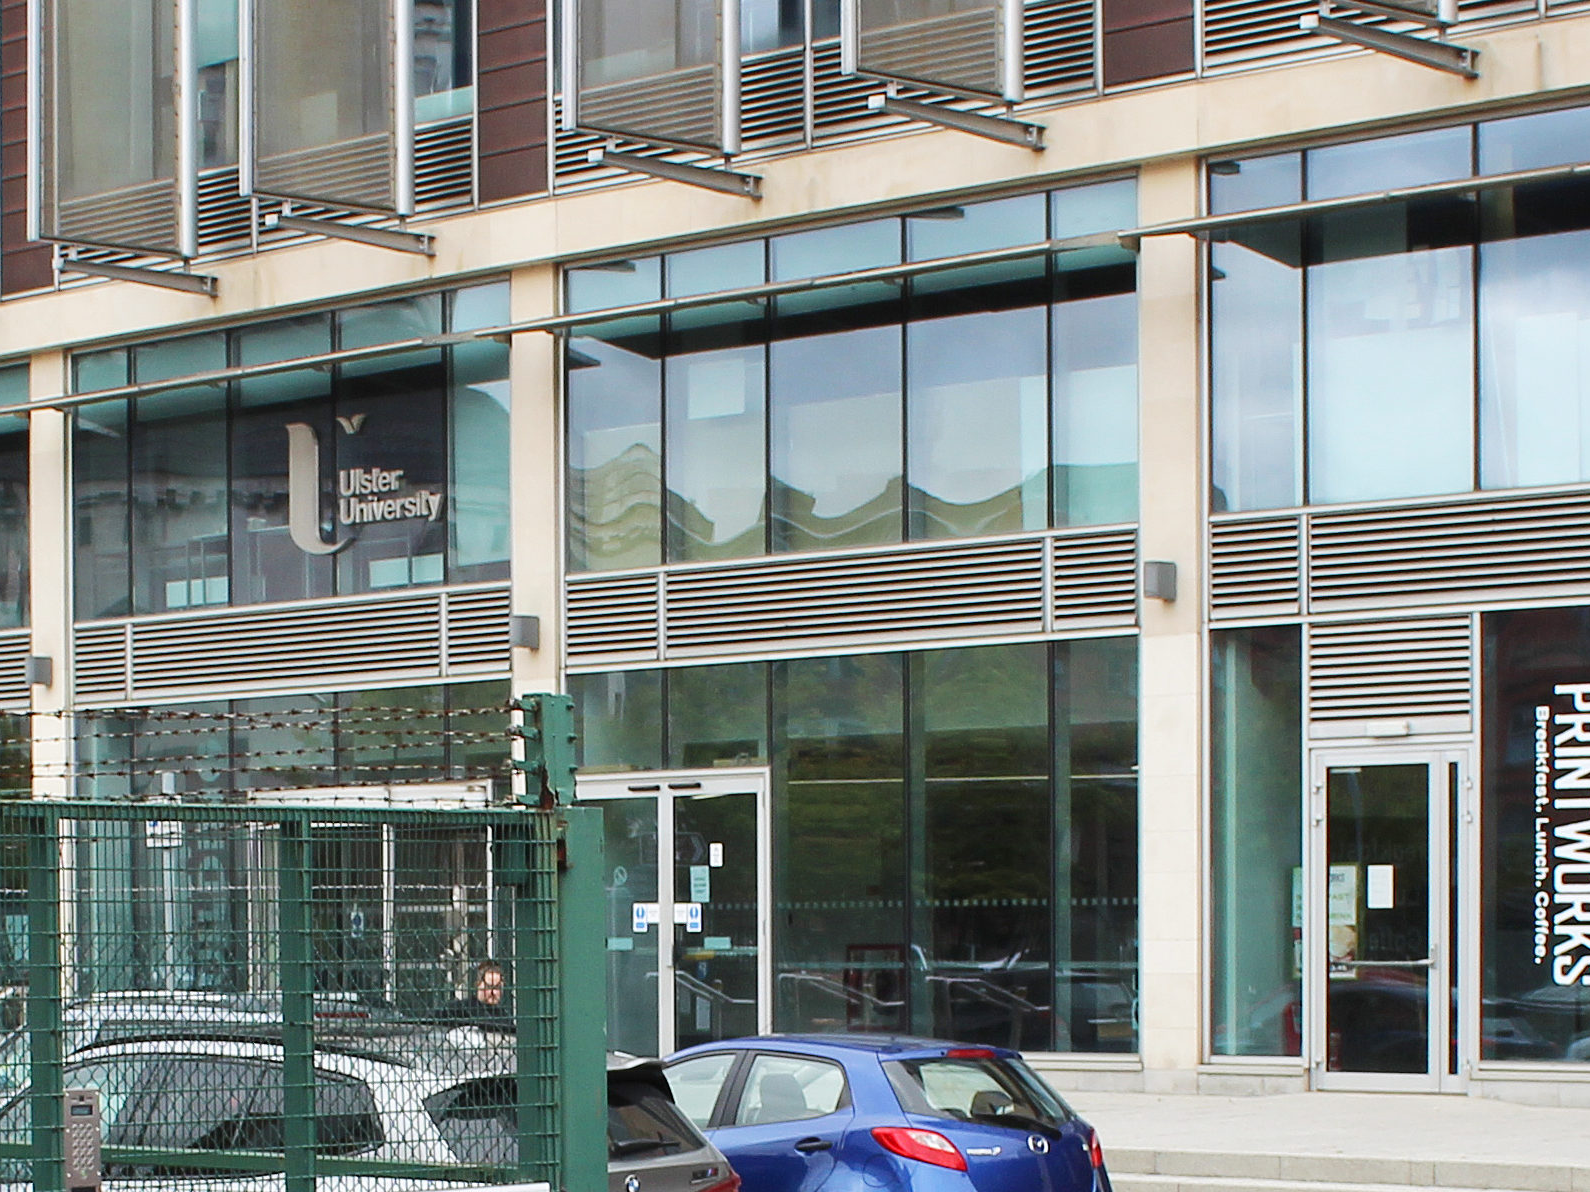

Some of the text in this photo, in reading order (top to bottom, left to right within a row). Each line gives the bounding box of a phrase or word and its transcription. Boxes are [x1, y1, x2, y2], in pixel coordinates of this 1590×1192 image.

[339, 467, 404, 497] Ulster
[339, 490, 442, 525] University
[1534, 706, 1550, 965] Breakfast. Lunch. Coffee.
